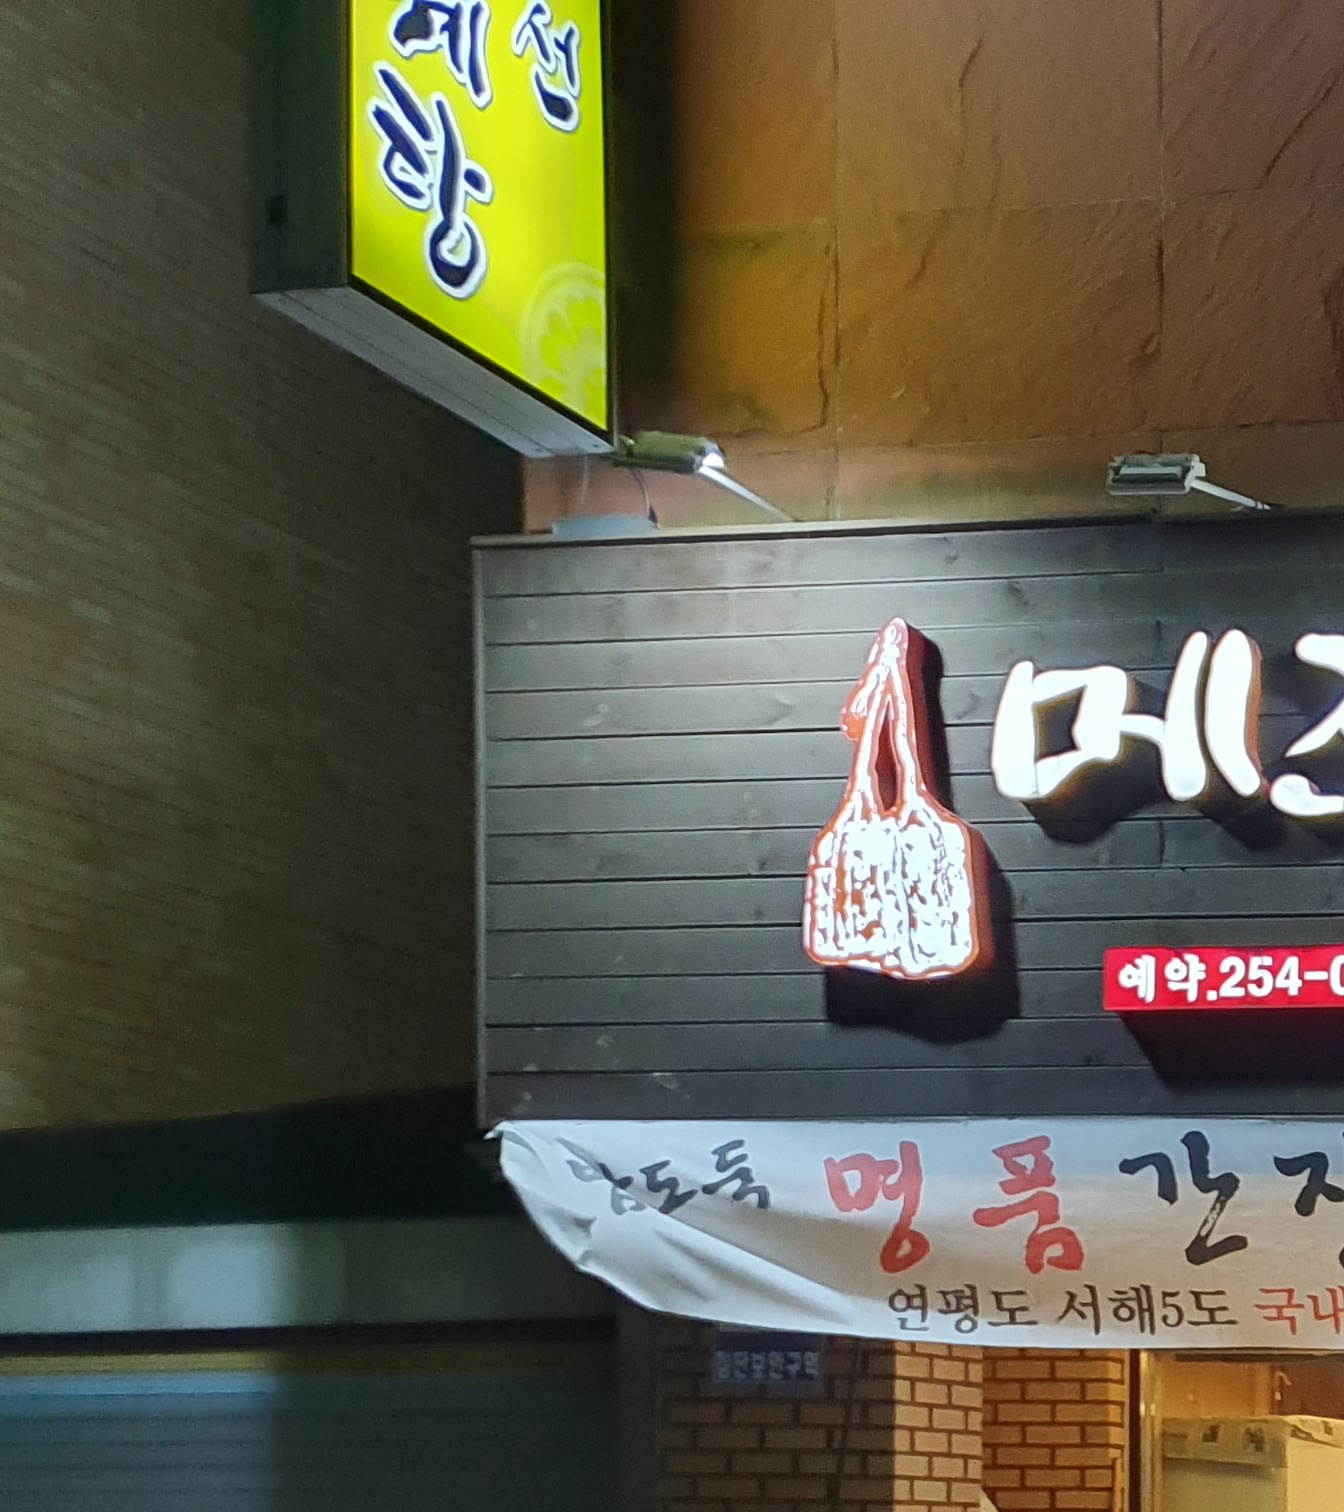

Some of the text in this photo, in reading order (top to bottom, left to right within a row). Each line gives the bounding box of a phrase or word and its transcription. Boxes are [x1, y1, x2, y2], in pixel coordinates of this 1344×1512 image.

[825, 1134, 1085, 1274] 명품
[887, 1286, 1038, 1332] 연평도
[1056, 1285, 1239, 1335] 서해5도
